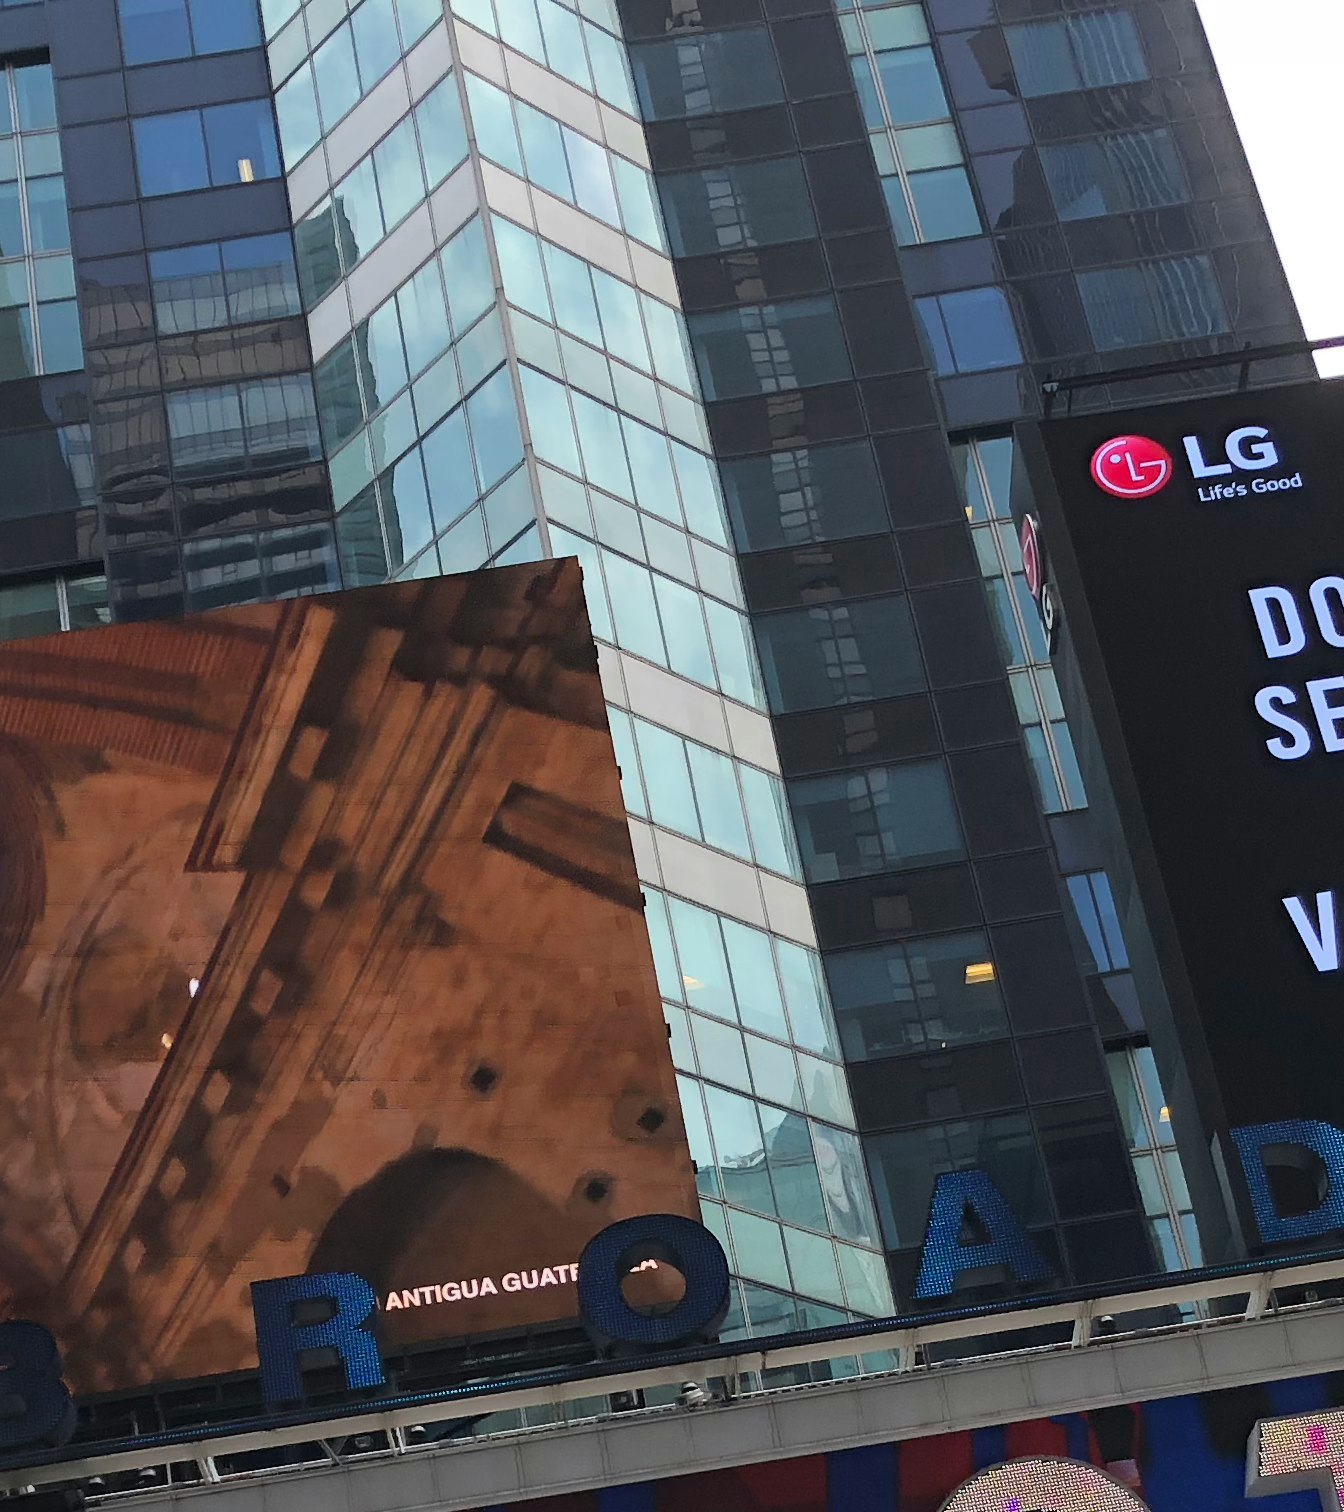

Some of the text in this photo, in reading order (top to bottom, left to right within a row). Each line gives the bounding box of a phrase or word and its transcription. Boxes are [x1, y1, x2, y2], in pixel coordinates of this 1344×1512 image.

[1182, 425, 1279, 479] LG
[1197, 472, 1303, 502] Life's Good
[385, 1276, 499, 1311] ANTIGUA
